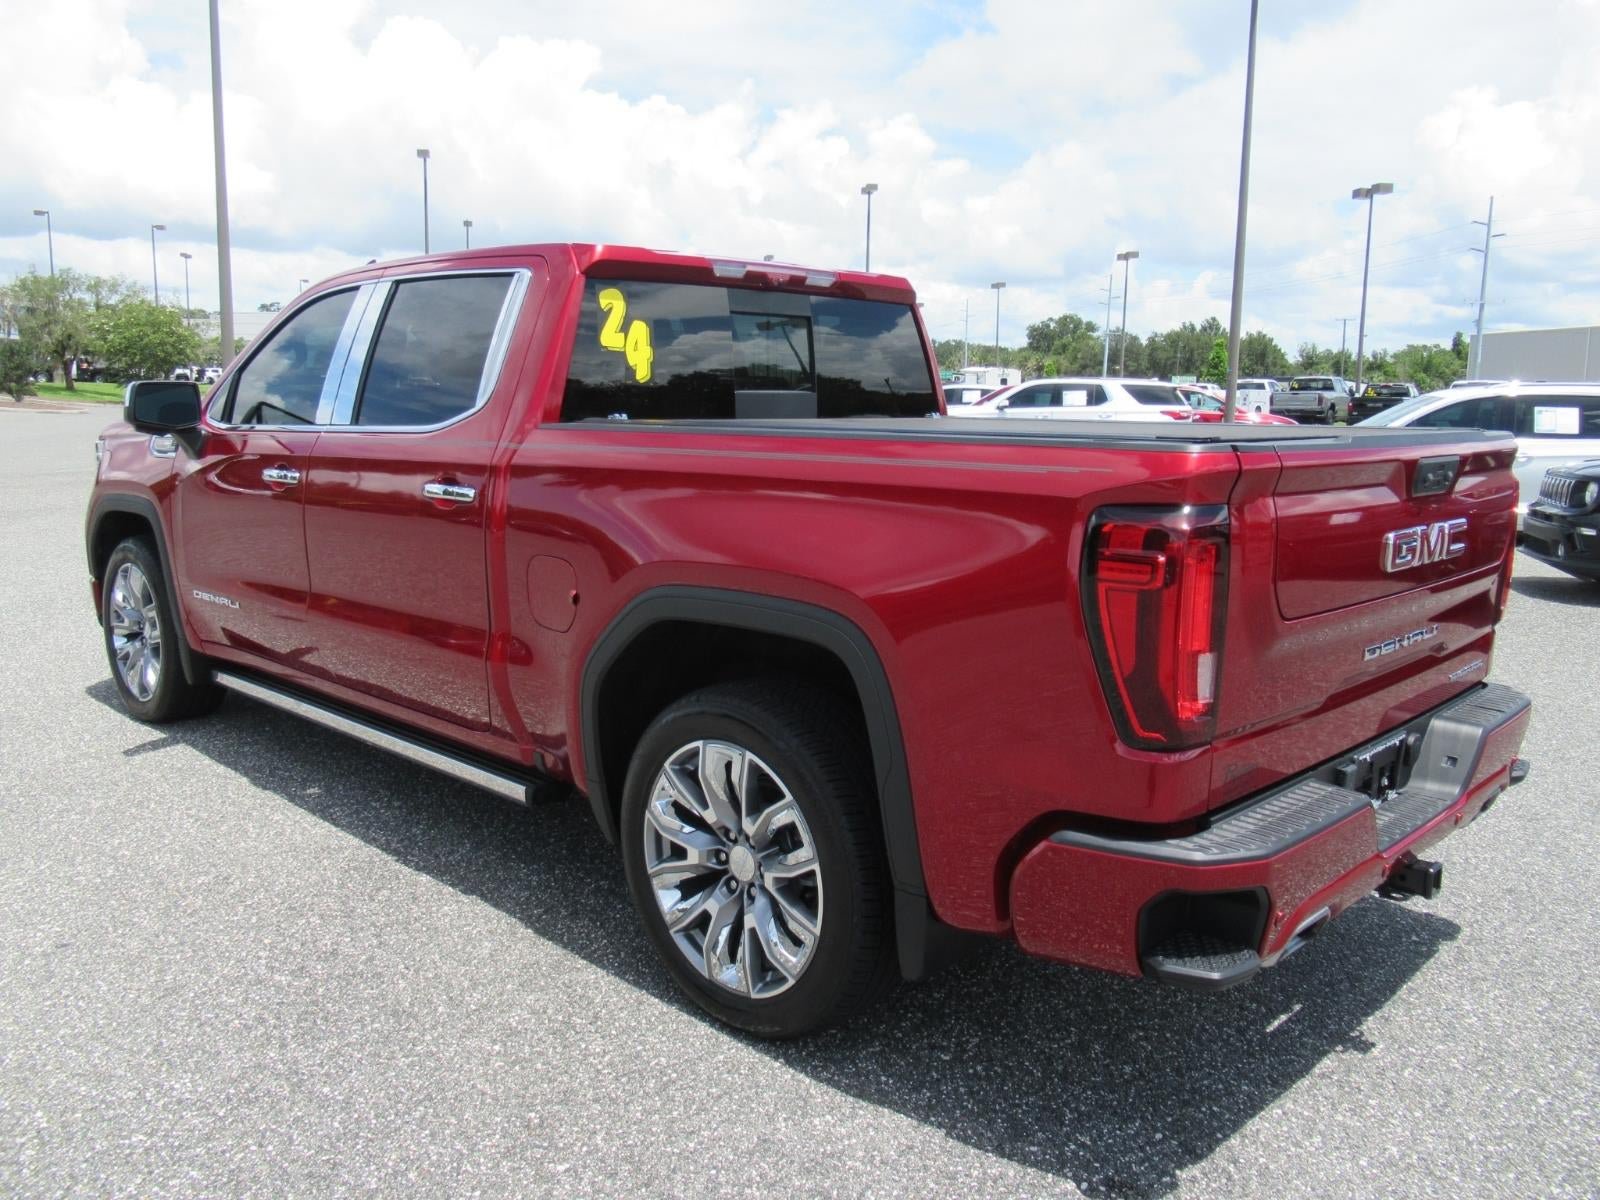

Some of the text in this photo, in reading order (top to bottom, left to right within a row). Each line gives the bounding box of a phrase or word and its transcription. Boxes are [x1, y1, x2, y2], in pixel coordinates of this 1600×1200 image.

[599, 287, 653, 384] 24
[1380, 518, 1468, 573] GMC
[192, 589, 241, 609] DENALI
[1363, 623, 1440, 661] DENALI
